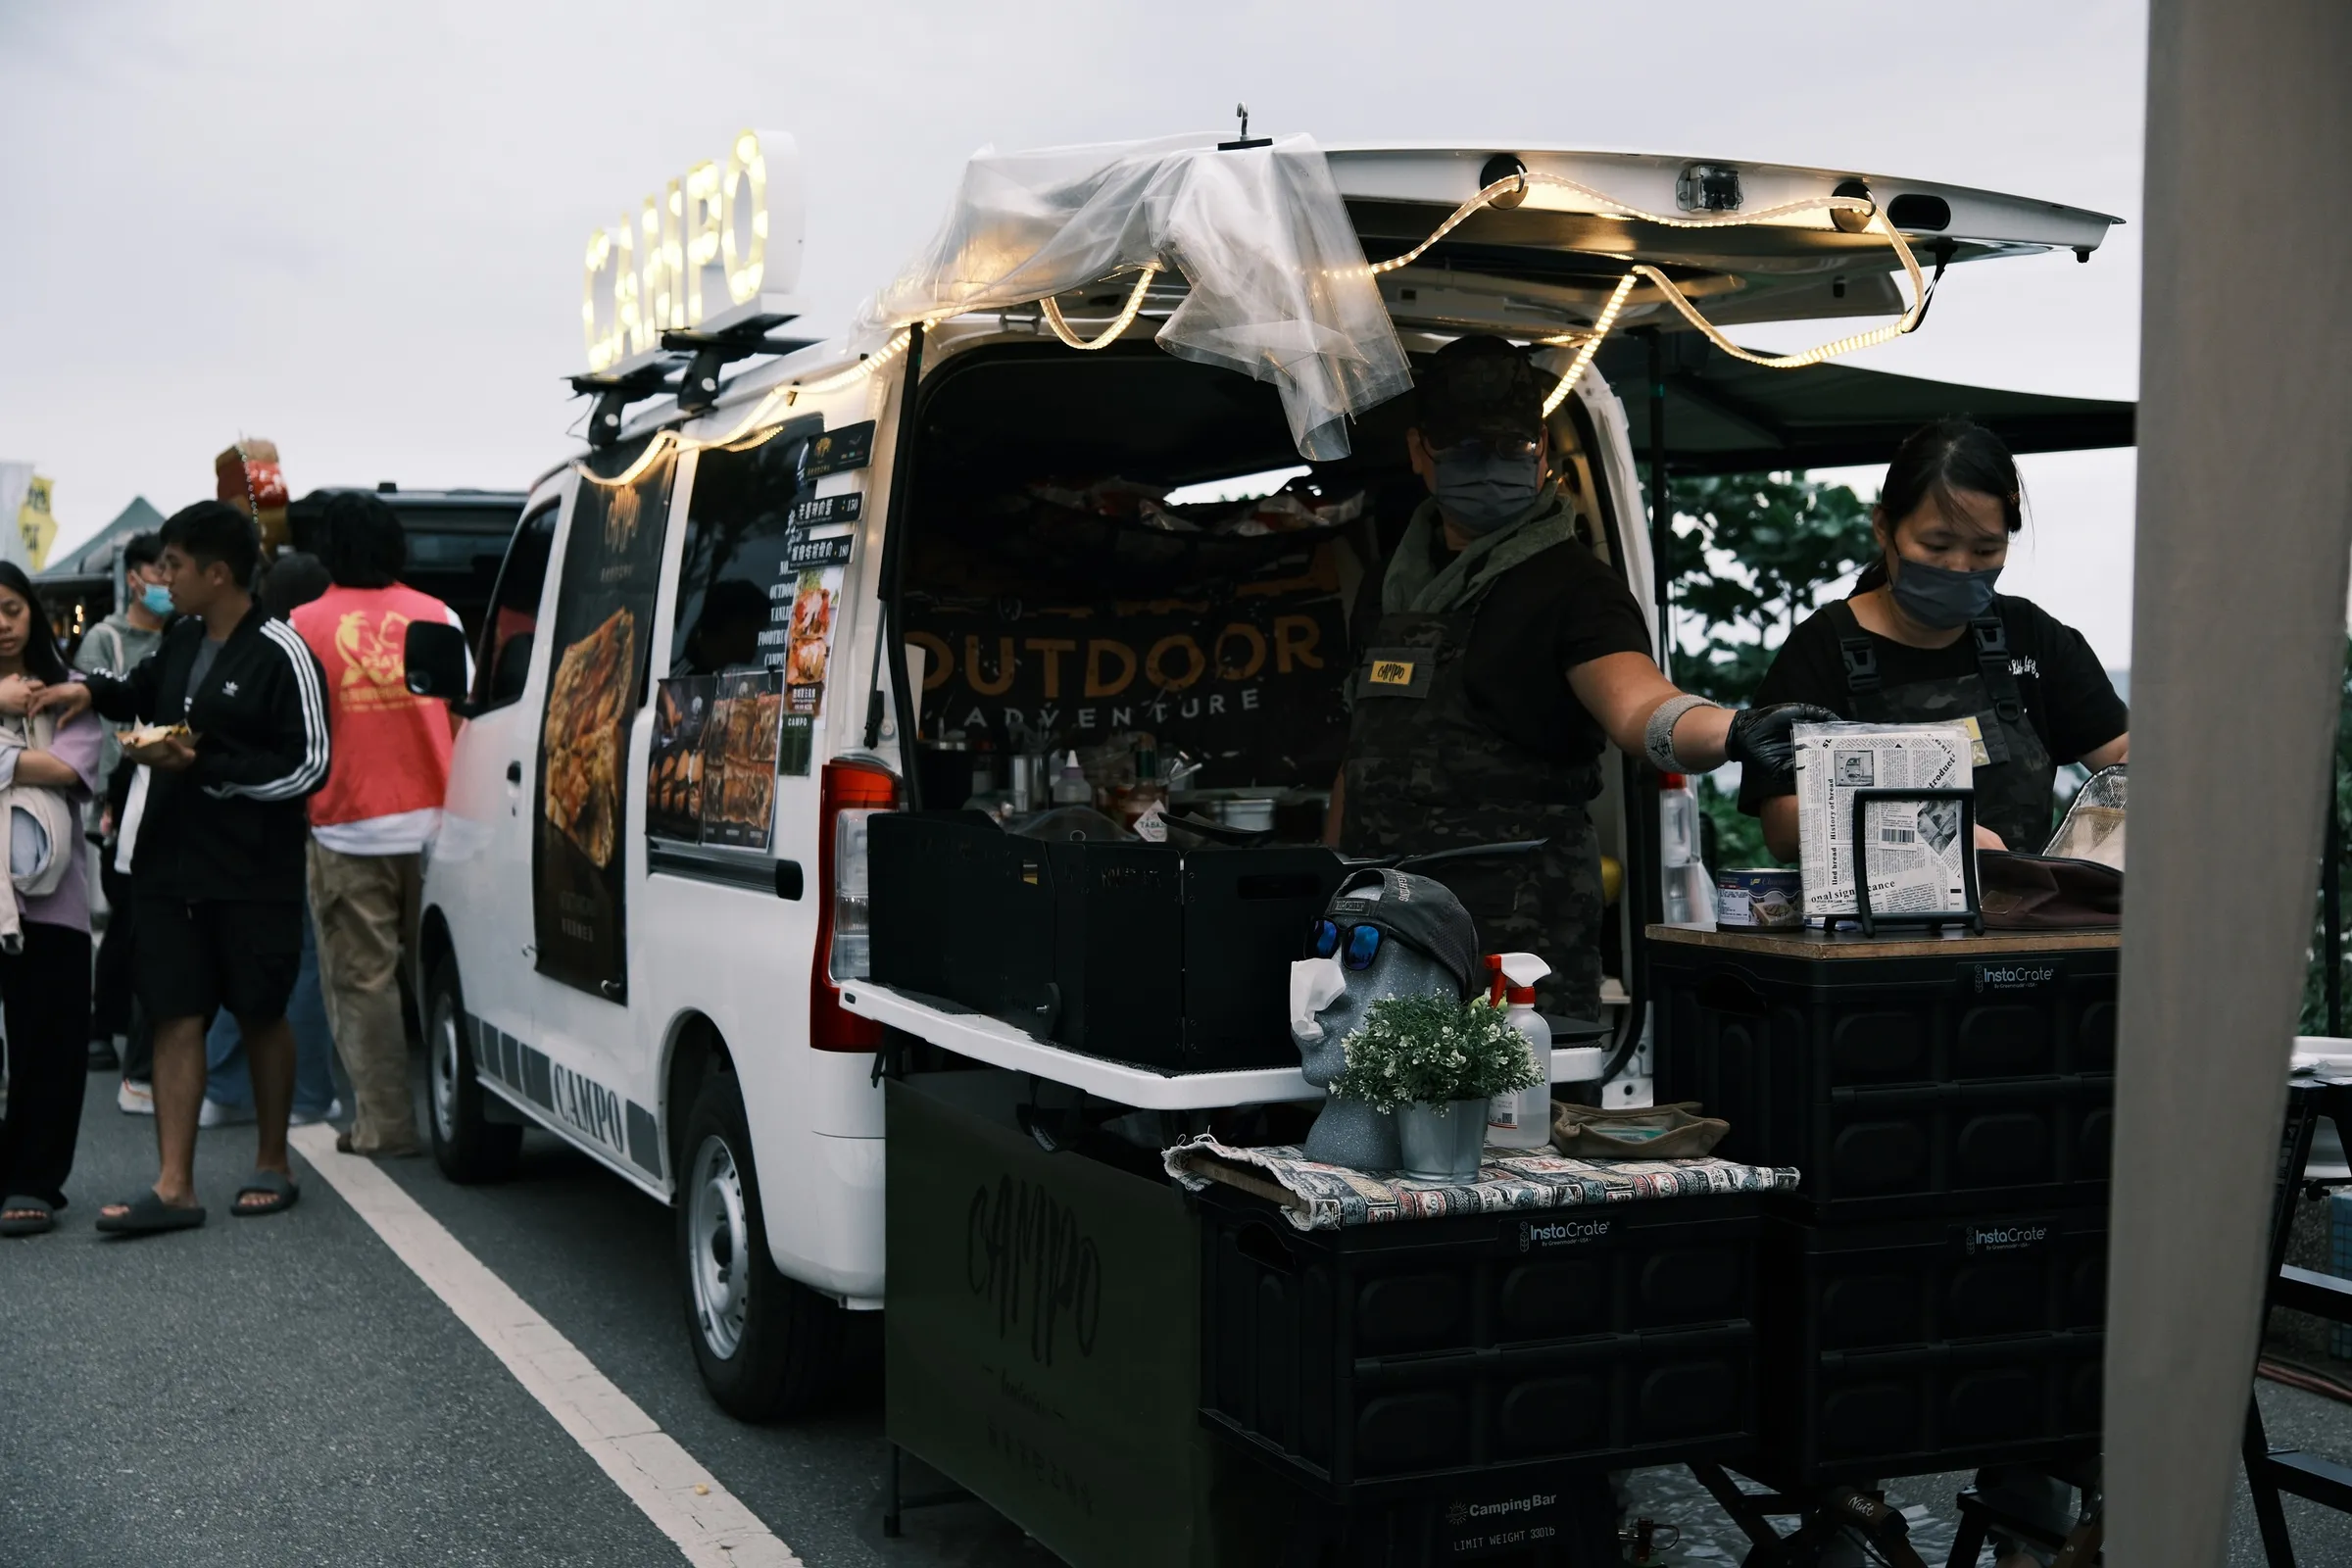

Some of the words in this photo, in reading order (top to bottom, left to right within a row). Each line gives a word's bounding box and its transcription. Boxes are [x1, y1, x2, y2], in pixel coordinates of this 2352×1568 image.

[582, 127, 770, 374] CAMPO
[769, 581, 796, 601] OUTDOO
[1377, 662, 1405, 682] CAMPO
[964, 688, 1260, 728] ADVENTURE
[787, 716, 808, 727] CAMPO
[1984, 966, 2052, 983] InstaCrate
[554, 1062, 624, 1154] CAMPO
[1530, 1220, 1608, 1241] InstaCrate
[1976, 1226, 2045, 1245] InstaCrate
[967, 1173, 1102, 1368] CAMPO
[1453, 1537, 1485, 1551] LIMIT
[1489, 1530, 1526, 1545] WEIGHT
